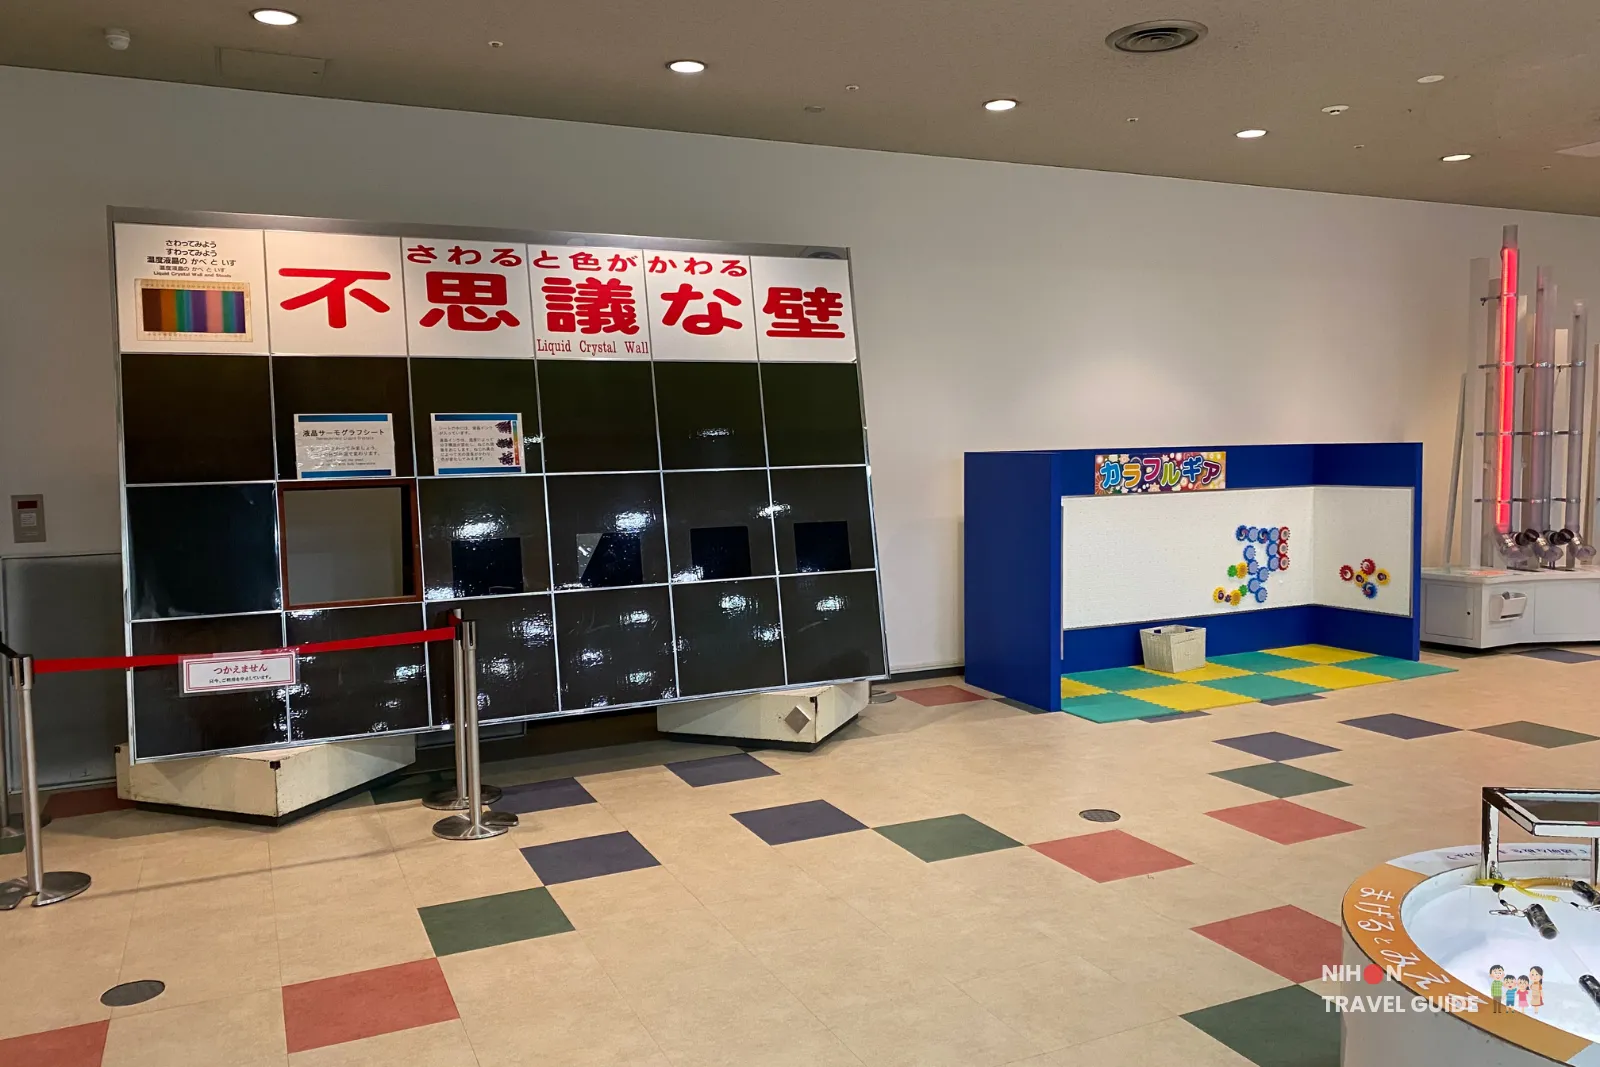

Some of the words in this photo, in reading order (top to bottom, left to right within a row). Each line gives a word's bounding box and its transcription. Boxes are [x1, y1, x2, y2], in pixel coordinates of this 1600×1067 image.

[165, 240, 217, 248] さわってみよう
[165, 248, 218, 257] すわってみよう
[146, 256, 188, 265] 温度液晶の
[221, 259, 237, 267] いす
[407, 244, 748, 277] さわると色がかわる
[278, 267, 846, 338] 不思議な壁
[537, 339, 572, 355] Liquid
[579, 340, 617, 356] Crystal
[625, 341, 649, 354] Wall
[302, 429, 385, 437] 液晶サーモグラフシート
[1100, 456, 1221, 488] カラフルギア
[213, 664, 268, 675] つかえません
